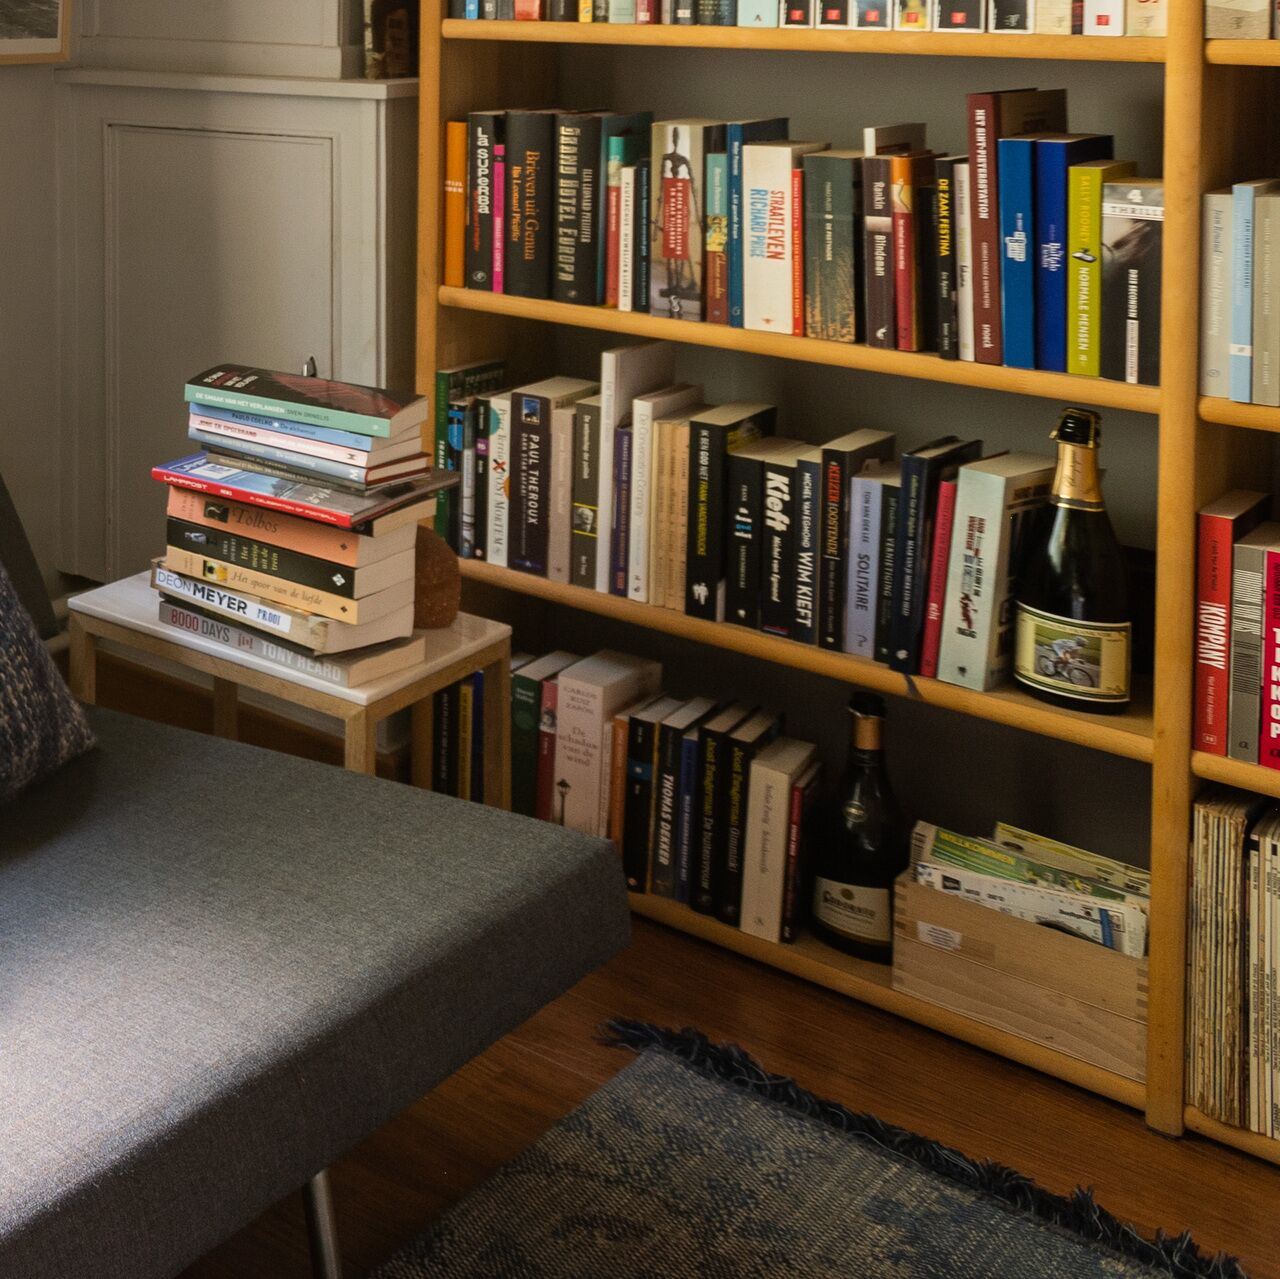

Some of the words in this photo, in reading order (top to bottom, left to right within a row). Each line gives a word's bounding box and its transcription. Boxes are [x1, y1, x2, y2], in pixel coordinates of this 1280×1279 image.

[524, 149, 540, 197] Brieven
[938, 178, 948, 190] DE
[1079, 175, 1090, 202] SALLY
[524, 199, 539, 216] uit
[749, 188, 768, 233] RICHARD
[871, 181, 885, 210] Rankin
[938, 192, 948, 217] ZAAK
[524, 218, 539, 261] Genua
[766, 189, 785, 261] STRAATLEVEN
[938, 218, 949, 257] FESTINA
[1079, 204, 1090, 243] ROONEY
[749, 234, 766, 259] PRICE
[873, 234, 886, 277] Blindeman
[1078, 266, 1090, 311] NORMALE
[1076, 311, 1088, 351] MENSEN
[195, 391, 203, 400] DE
[204, 393, 224, 404] SMAAK
[225, 397, 236, 406] VAN
[237, 399, 249, 408] HET
[250, 401, 285, 414] VERLANGEN
[527, 433, 539, 464] PAUL
[527, 468, 539, 525] THEROUX
[764, 471, 790, 534] Kieft
[802, 471, 811, 500] MICHEL
[826, 463, 839, 503] KEIZER
[802, 500, 811, 516] VAN
[771, 534, 781, 560] Michel
[801, 515, 811, 549] EGMOND
[826, 505, 837, 557] OOSTENDE
[770, 559, 778, 574] van
[796, 548, 814, 583] WIM
[881, 536, 894, 598] VERNIETIGING
[230, 571, 249, 585] Het
[250, 577, 271, 590] spoor
[272, 585, 287, 594] van
[290, 587, 300, 598] de
[301, 590, 323, 605] liefde
[769, 573, 780, 602] Egmond
[794, 583, 814, 629] KIEFT
[171, 608, 199, 632] 8000
[201, 619, 230, 643] DAYS
[704, 736, 717, 764] Joost
[731, 746, 744, 774] Joost
[657, 771, 674, 822] THOMAS
[703, 763, 715, 818] Zwagerman
[729, 772, 743, 828] Zwagerman
[657, 819, 672, 867] DEKKER
[704, 816, 715, 832] De
[701, 830, 715, 891] buitenvrouw
[727, 825, 743, 875] Gimmick!
